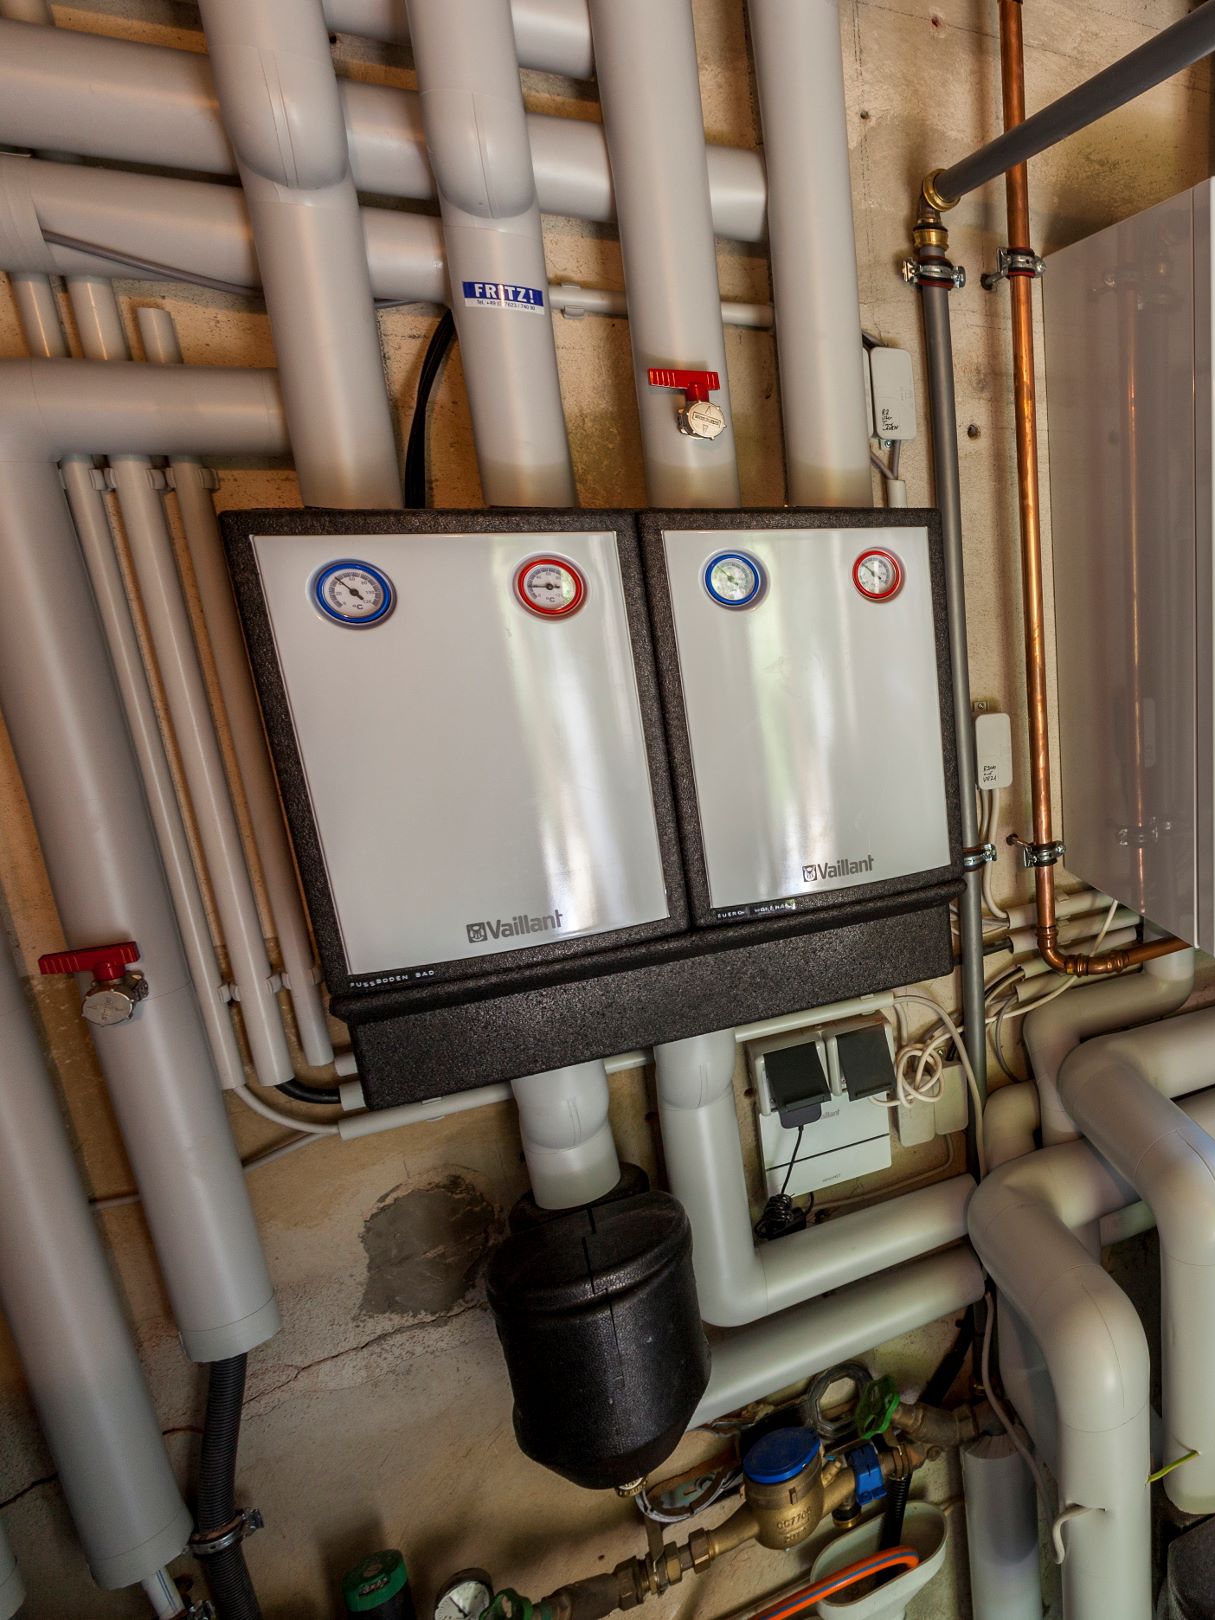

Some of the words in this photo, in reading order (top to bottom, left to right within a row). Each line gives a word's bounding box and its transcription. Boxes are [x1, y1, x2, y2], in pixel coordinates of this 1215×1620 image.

[474, 283, 534, 303] FRITZ!
[816, 855, 874, 879] Vaillant
[486, 909, 563, 940] Vaillant
[350, 974, 409, 988] FUSSBODEN
[415, 969, 435, 978] BAD
